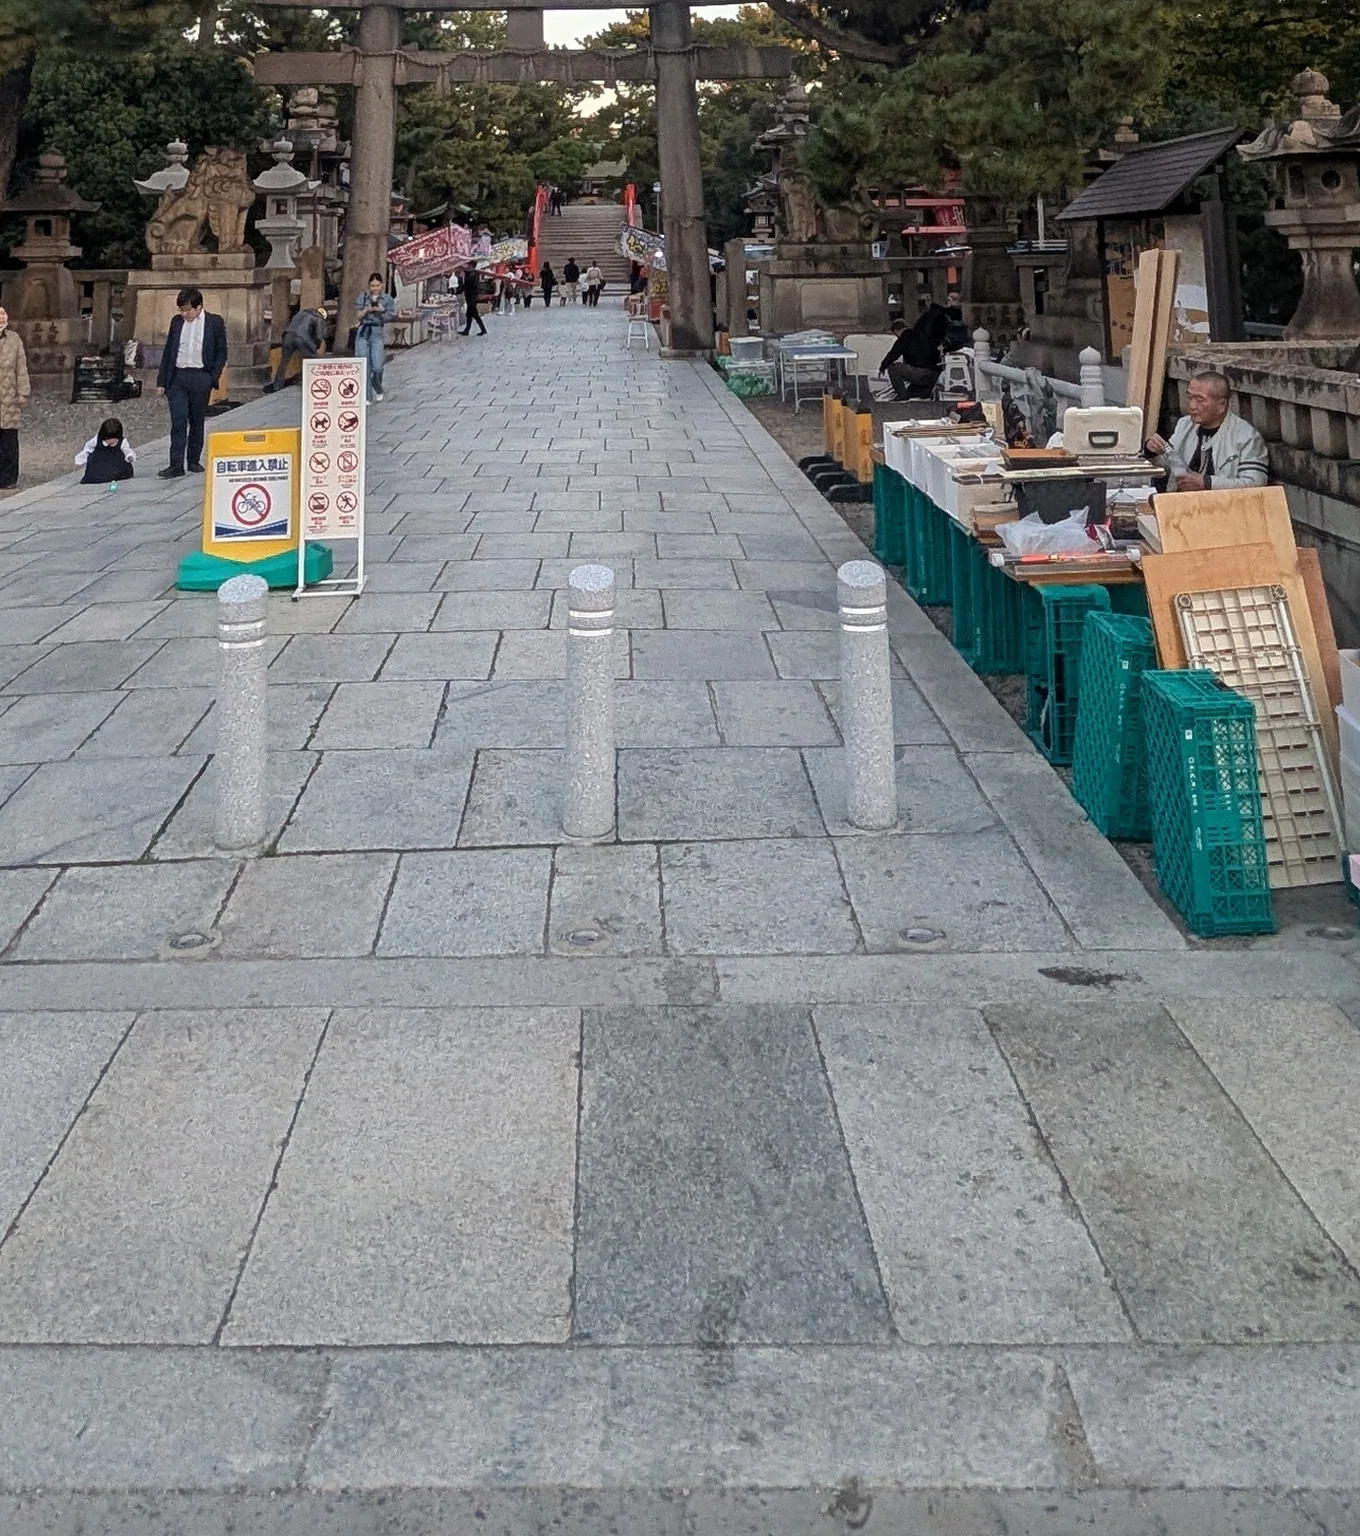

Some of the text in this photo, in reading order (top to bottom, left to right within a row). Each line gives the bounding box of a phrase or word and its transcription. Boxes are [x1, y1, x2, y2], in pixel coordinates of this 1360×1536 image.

[216, 458, 289, 474] 自転車進入禁止
